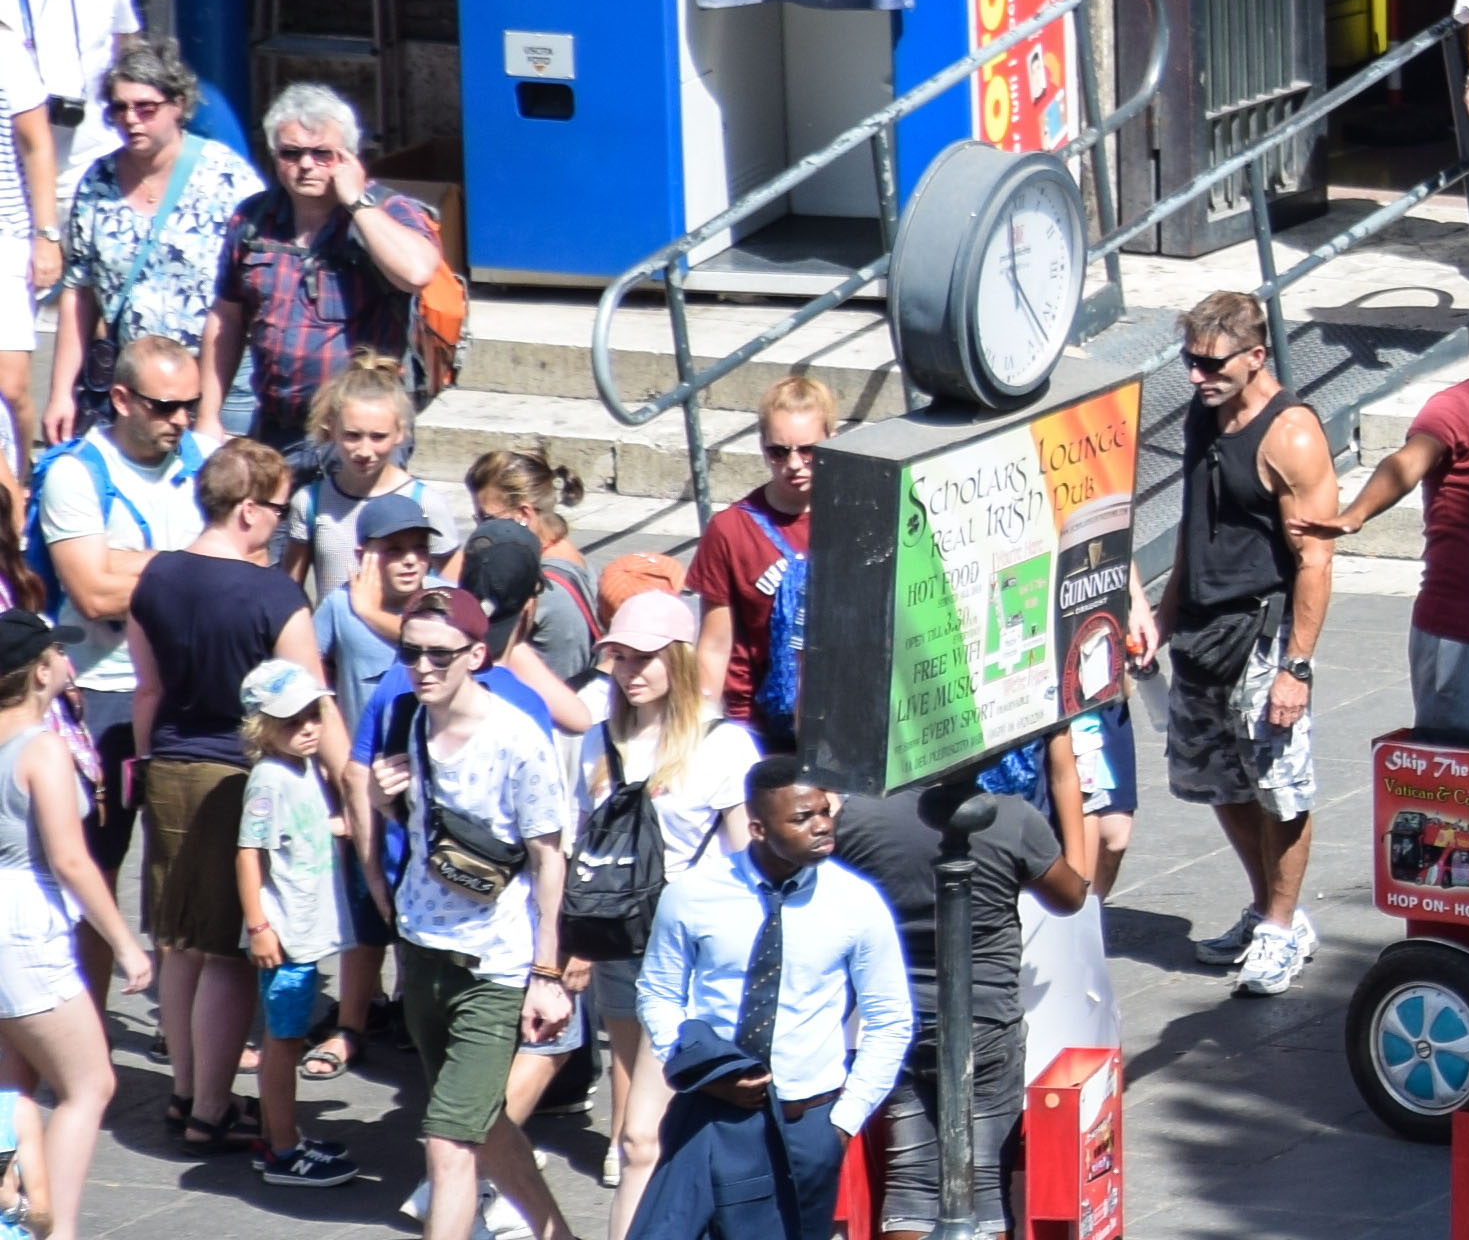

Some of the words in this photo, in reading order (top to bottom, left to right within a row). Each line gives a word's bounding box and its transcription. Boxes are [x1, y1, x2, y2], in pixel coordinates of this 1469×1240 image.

[907, 576, 938, 608] HOT
[942, 561, 980, 596] FOOD
[1059, 565, 1126, 609] GUINNESS
[913, 653, 948, 684] FREE
[953, 639, 981, 666] WIFI
[897, 692, 929, 723] LIVE
[936, 671, 980, 707] MUSIC
[921, 717, 957, 746] EVERY
[960, 700, 996, 729] SPORT
[1384, 751, 1428, 775] Skip
[1433, 757, 1469, 778] The
[1384, 778, 1435, 800] Vatican
[1436, 785, 1452, 800] &
[1387, 892, 1418, 910] HOP
